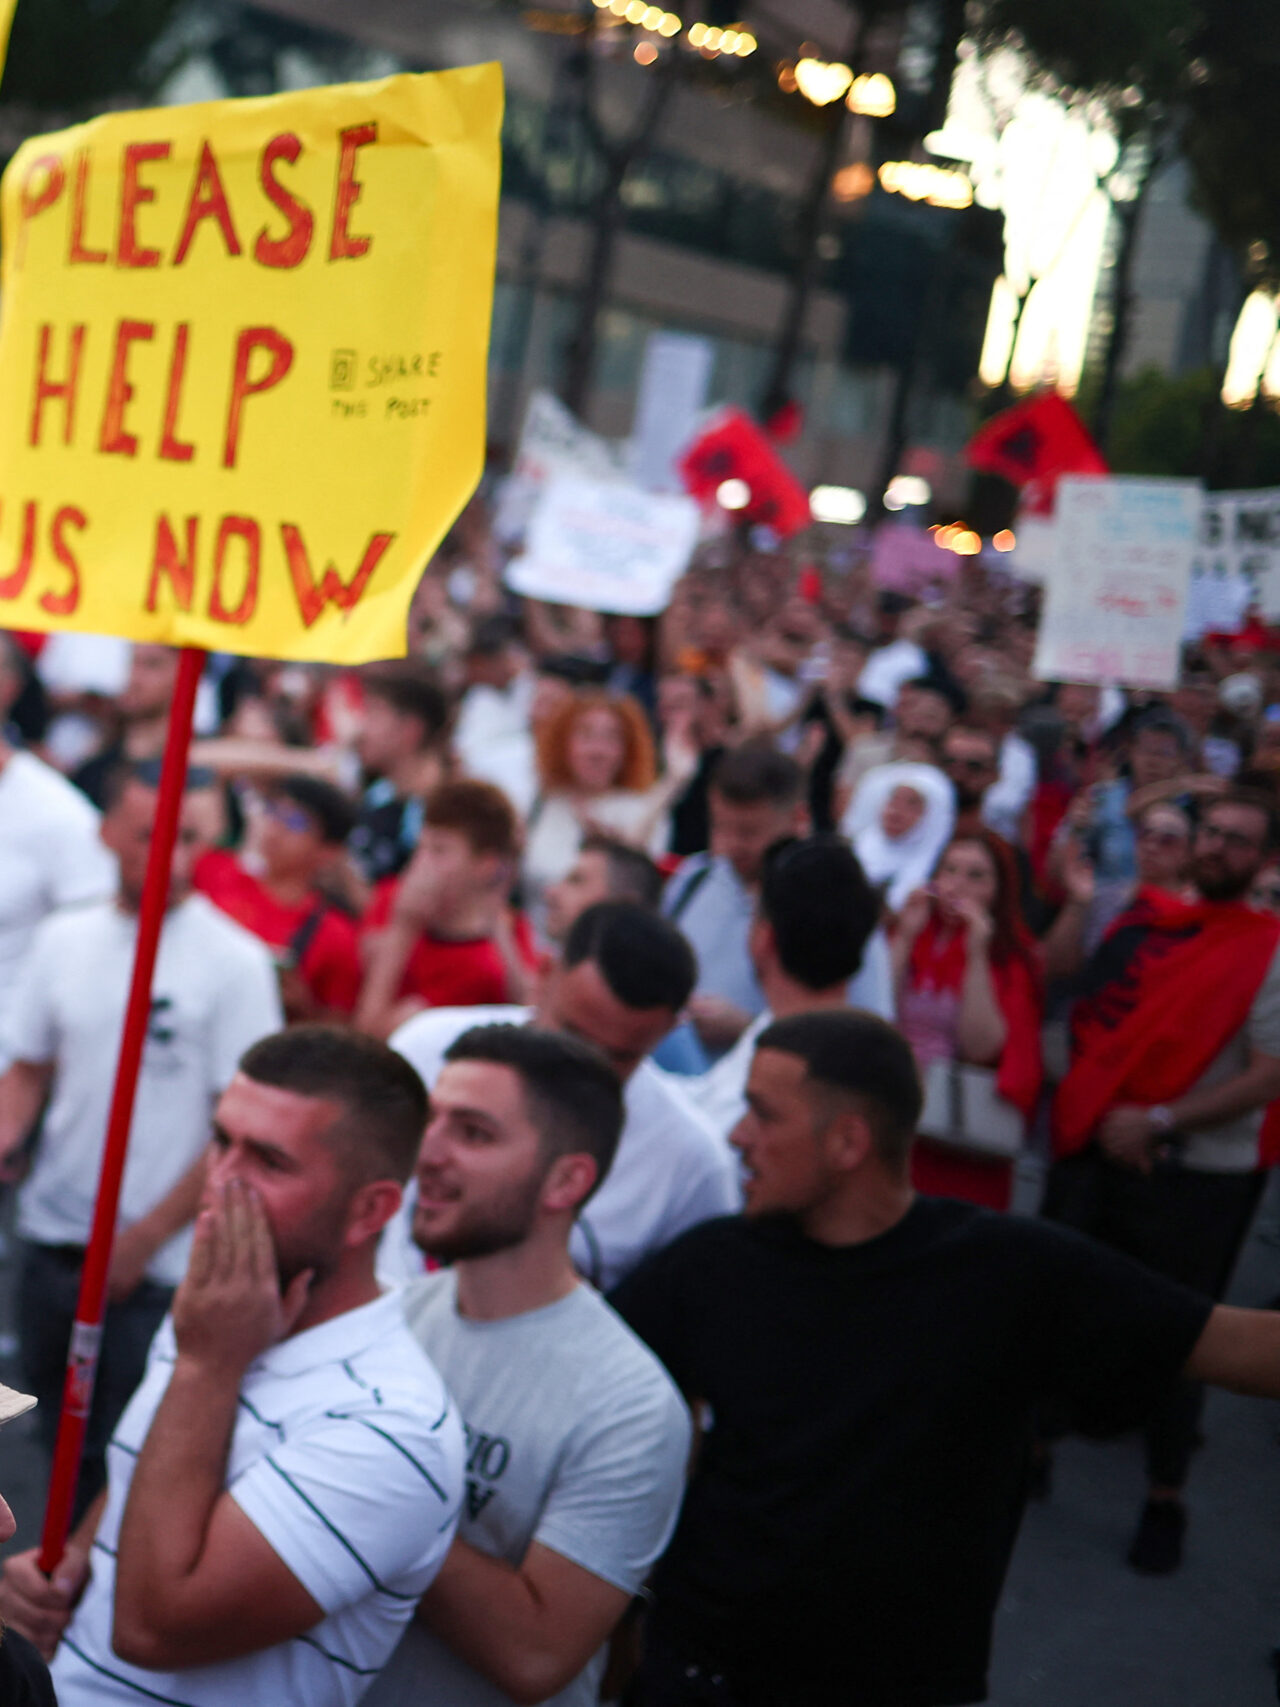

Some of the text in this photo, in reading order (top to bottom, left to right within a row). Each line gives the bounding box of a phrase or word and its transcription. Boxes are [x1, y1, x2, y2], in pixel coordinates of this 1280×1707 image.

[14, 120, 378, 270] PLEASE
[30, 320, 296, 469] HELP
[144, 510, 398, 630] NOW
